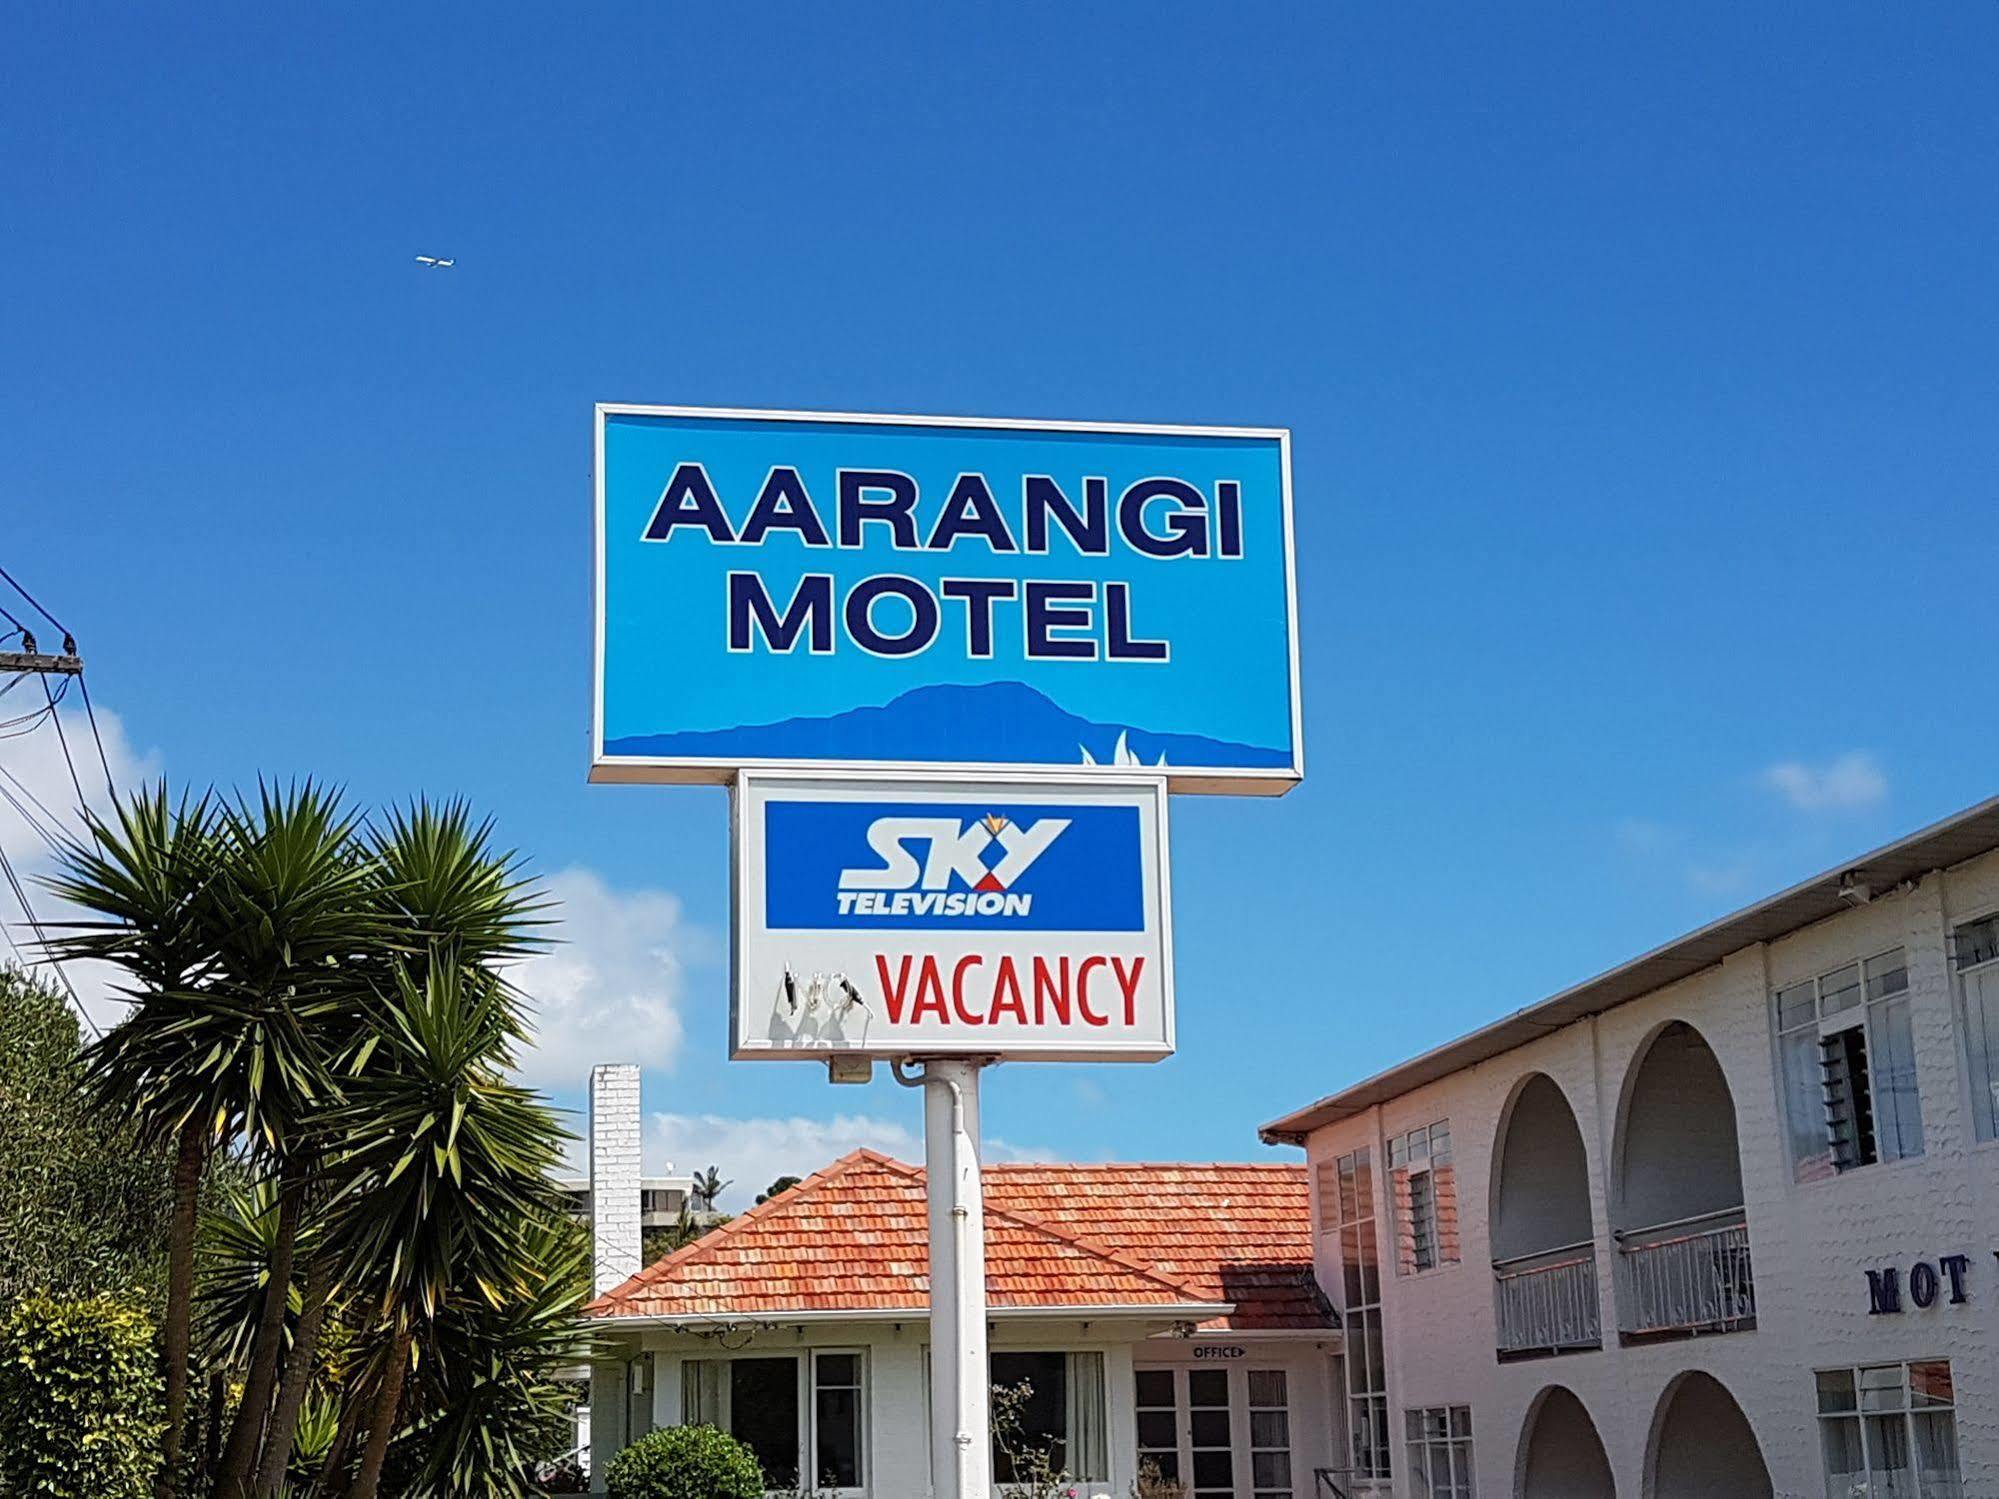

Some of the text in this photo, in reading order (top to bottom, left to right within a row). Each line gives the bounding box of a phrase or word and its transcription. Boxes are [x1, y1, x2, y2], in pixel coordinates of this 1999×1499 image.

[639, 462, 1244, 560] AARANGI
[727, 571, 1170, 664] MOTEL
[839, 816, 1073, 890] SKY
[836, 892, 1032, 917] TELEVISION
[875, 954, 1145, 1026] VACANCY
[1864, 1251, 1999, 1315] MOT
[1193, 1347, 1238, 1358] OFFICE
